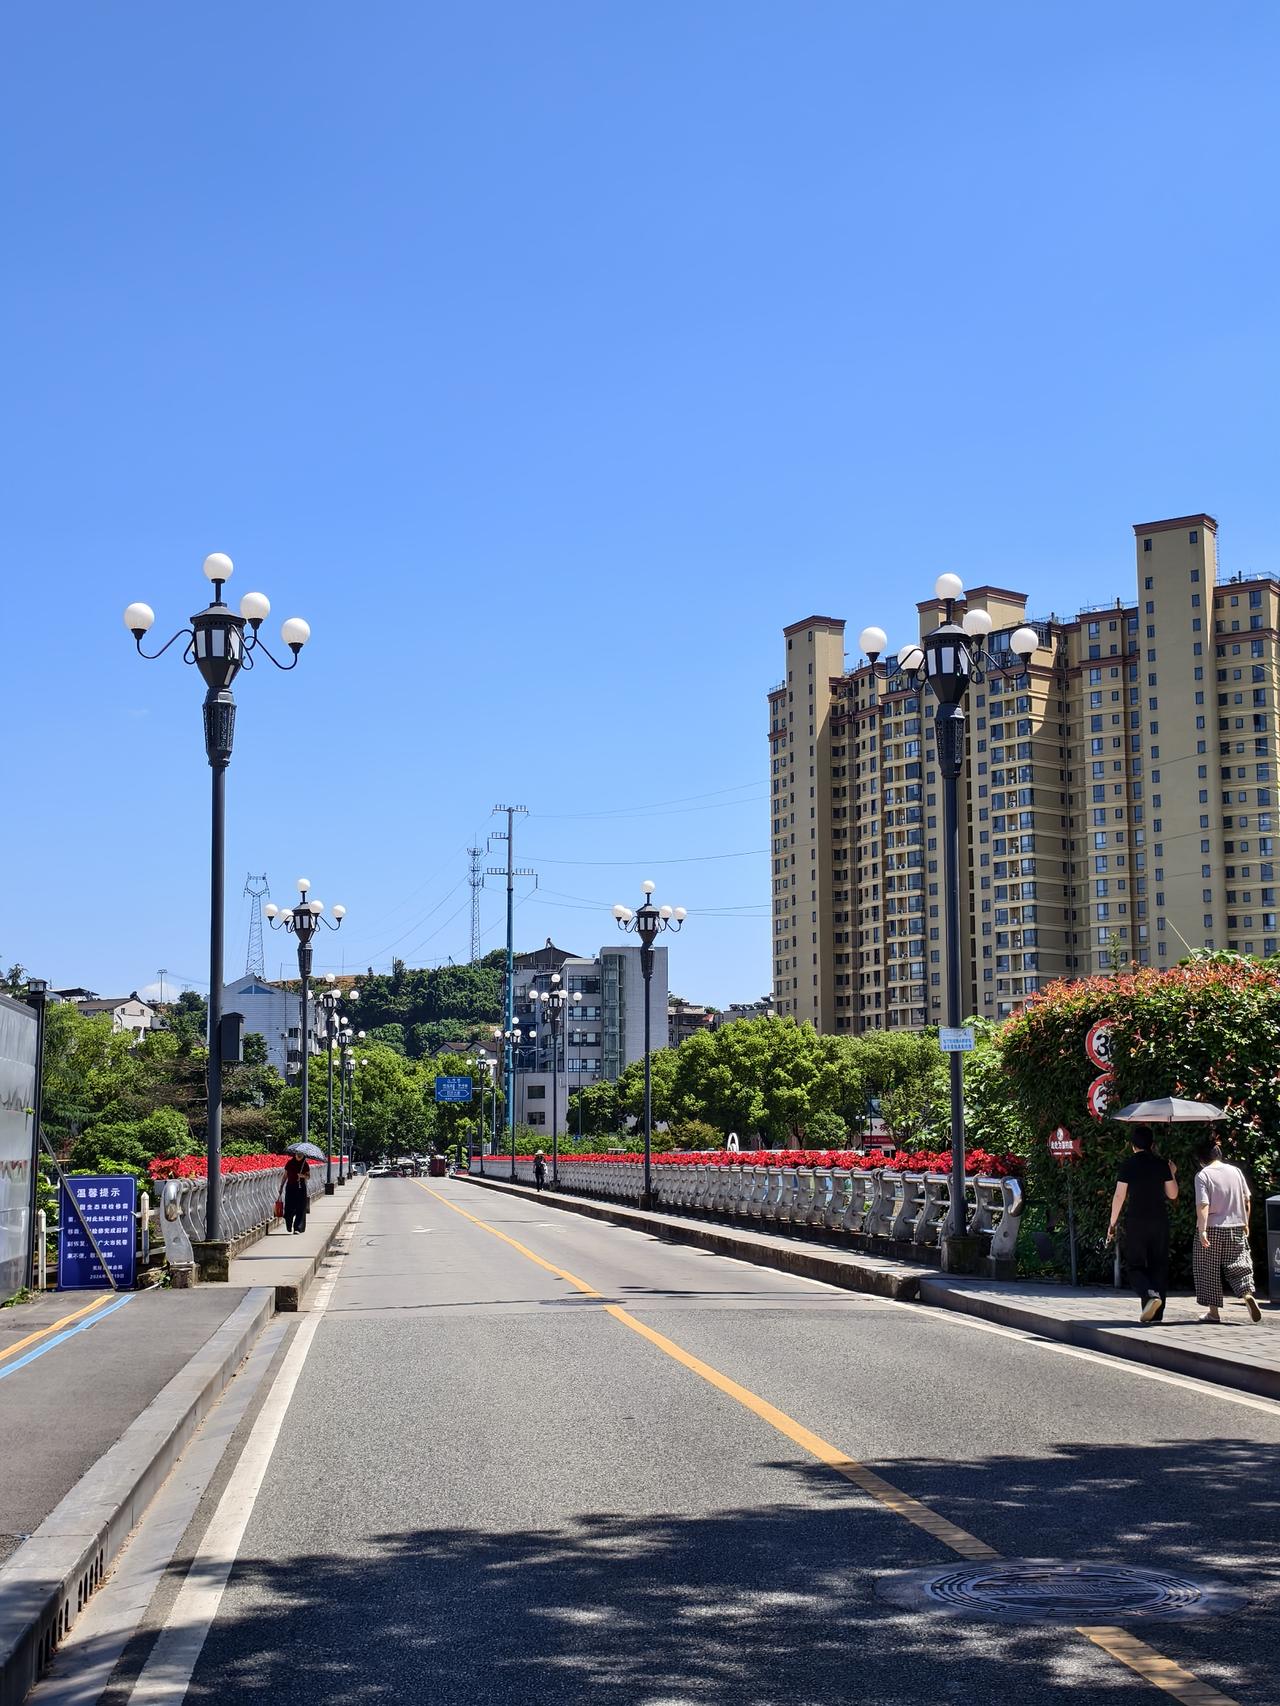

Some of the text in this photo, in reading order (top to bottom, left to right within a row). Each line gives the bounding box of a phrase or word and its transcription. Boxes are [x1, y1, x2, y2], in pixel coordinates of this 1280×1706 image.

[1095, 1033, 1114, 1057] 3
[77, 1188, 120, 1198] 温馨提示
